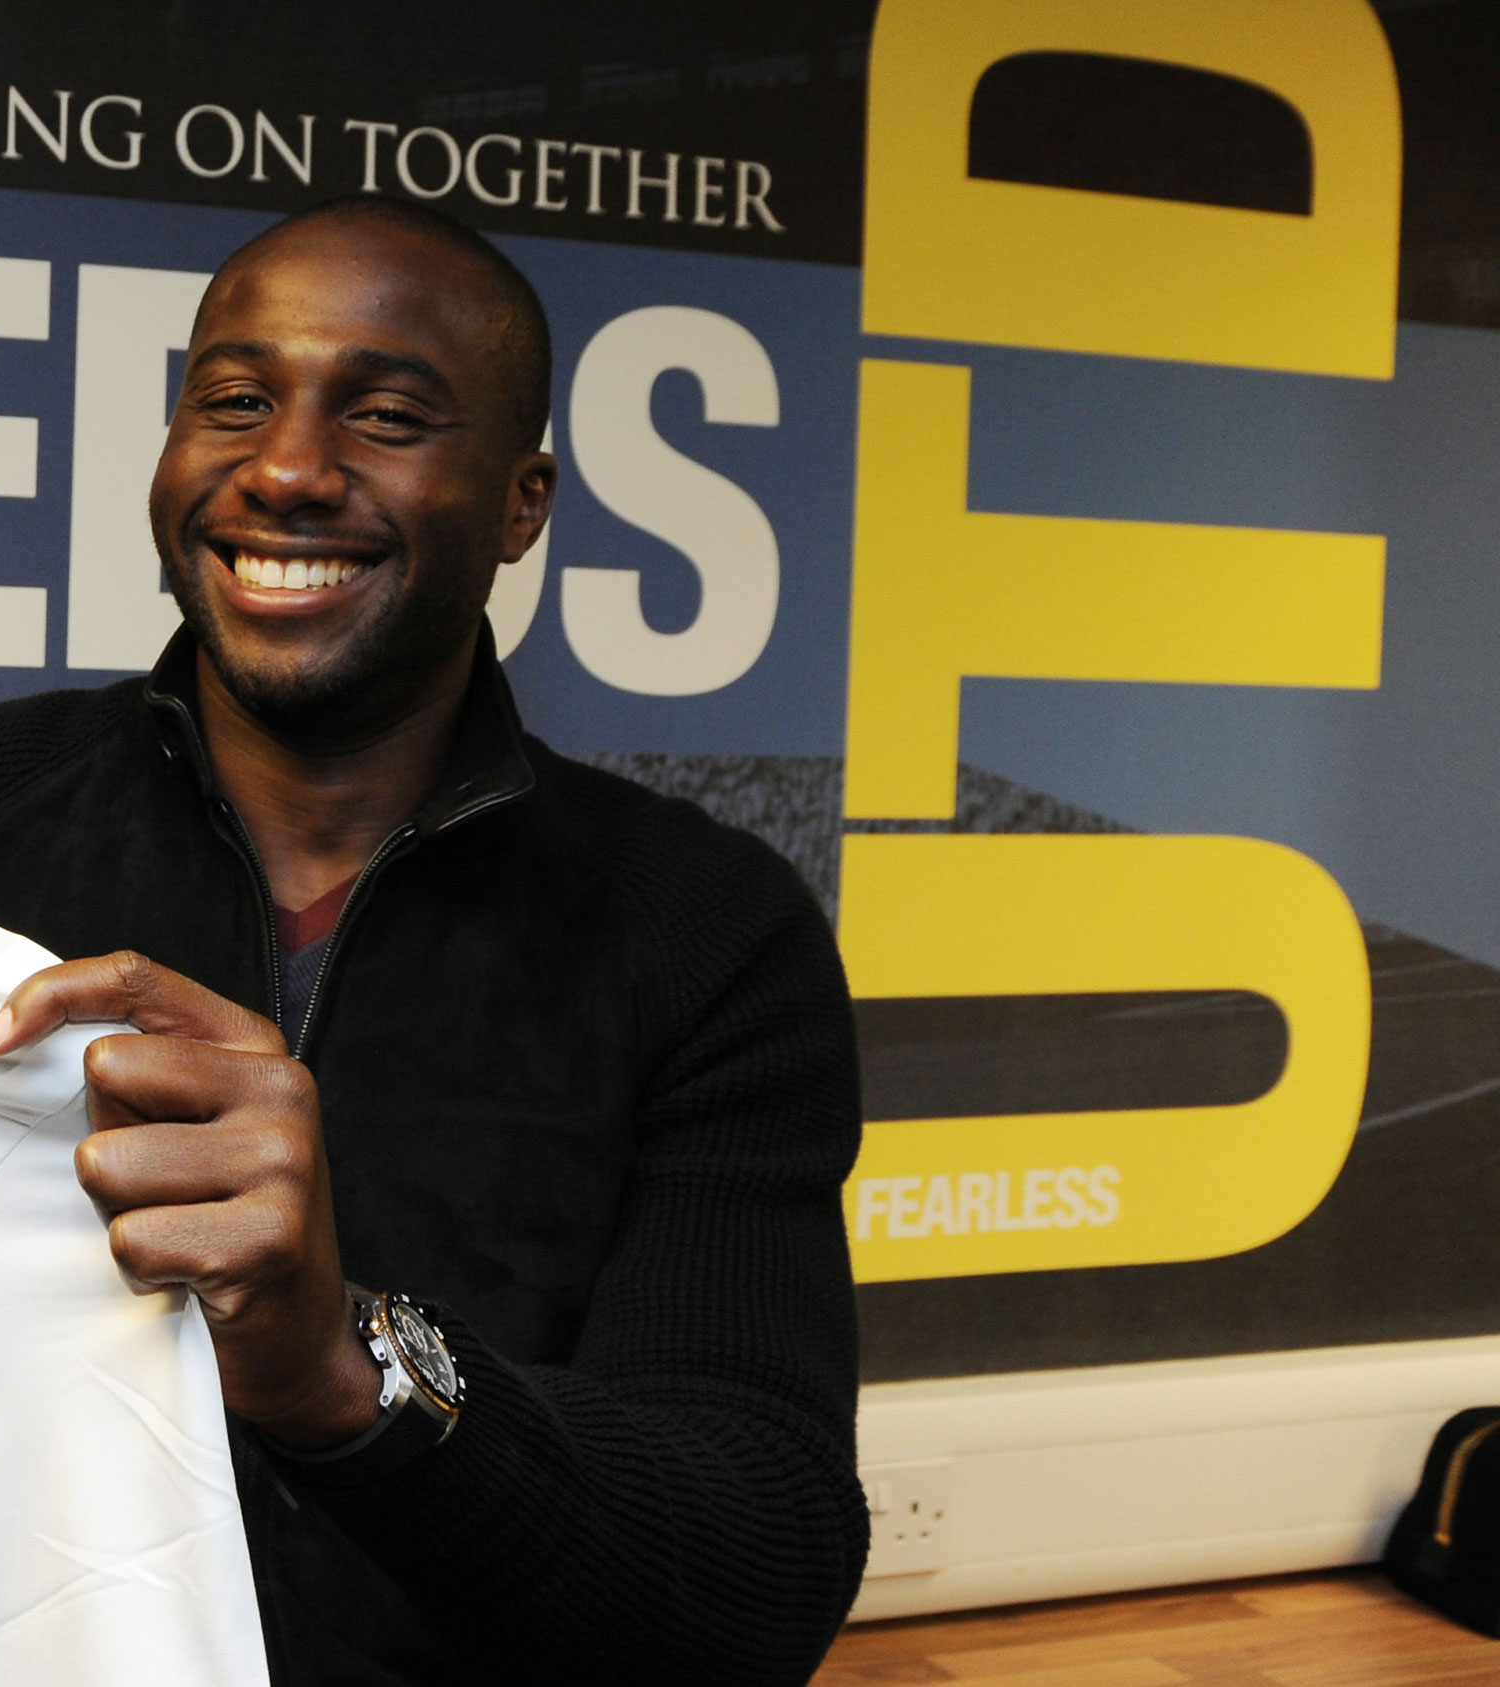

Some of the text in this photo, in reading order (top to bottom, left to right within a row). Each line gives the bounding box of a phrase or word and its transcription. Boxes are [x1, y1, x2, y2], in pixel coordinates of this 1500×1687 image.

[176, 104, 317, 185] ON
[344, 119, 788, 232] TOGETHER
[856, 1165, 1121, 1241] FEARLESS
